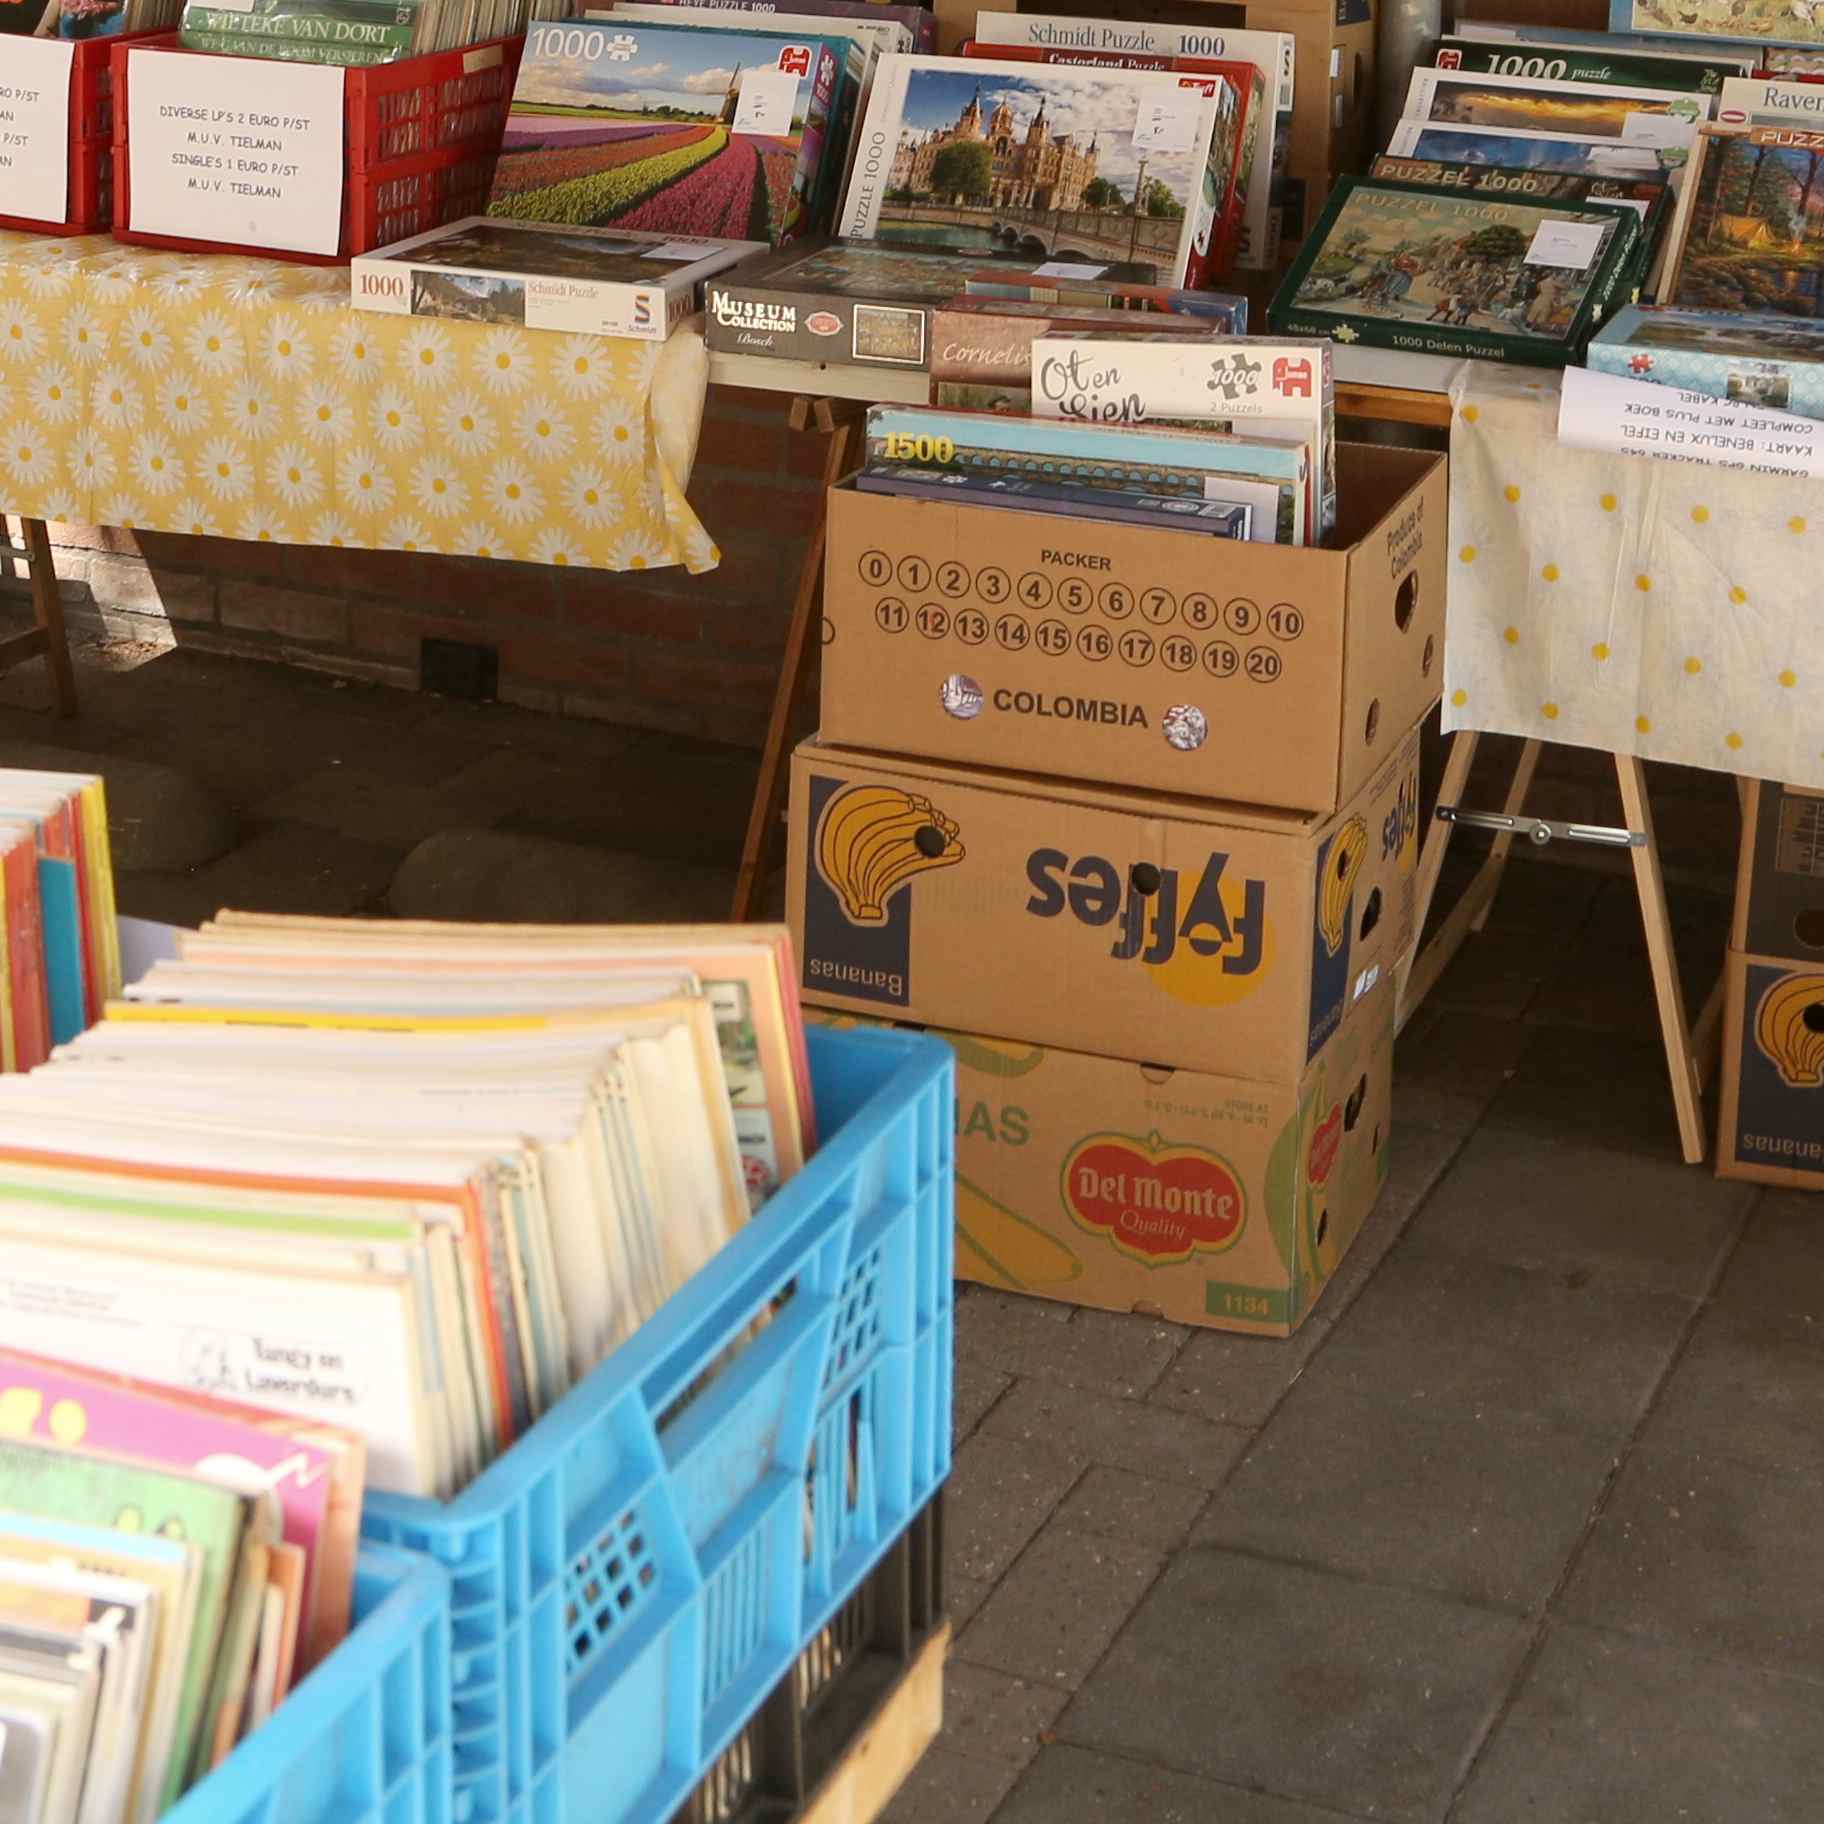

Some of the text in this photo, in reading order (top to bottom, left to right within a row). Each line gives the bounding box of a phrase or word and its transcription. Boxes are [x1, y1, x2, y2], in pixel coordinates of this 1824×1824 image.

[709, 0, 776, 14] PUZZLE 1000
[290, 18, 391, 43] VAN DORT
[1028, 24, 1225, 57] Schmidt Puzzle 1000
[532, 28, 604, 61] 1000
[1486, 54, 1612, 81] 1000 puzzle
[15, 88, 40, 102] P/ST
[160, 105, 310, 130] DIVERSE EURO P/ST
[3, 132, 29, 145] P/ST
[230, 135, 282, 151] TIELMAN
[238, 160, 299, 176] EURO P/ST
[1380, 164, 1537, 192] PUZZEL 1000
[188, 177, 281, 198] M.U.V. TIELMAN
[850, 131, 886, 238] PUZZLE 1000
[359, 273, 404, 297] 1000
[527, 280, 599, 300] Schmidt Puzzle
[1392, 335, 1505, 359] 1000 Delen Puzzel
[1212, 367, 1258, 385] 1000
[1221, 401, 1264, 415] Puzzels
[1624, 403, 1813, 435] COMPLEET MET PLUS BOEK
[884, 431, 956, 464] 1500
[1620, 425, 1755, 451] BENELUX EN EIFEL
[1041, 549, 1112, 571] PACKER
[993, 688, 1149, 729] COLOMBIA
[809, 957, 903, 996] Bananas
[1078, 1167, 1233, 1220] Del Monte
[1120, 1210, 1186, 1240] Quality
[1224, 1294, 1269, 1315] 1134
